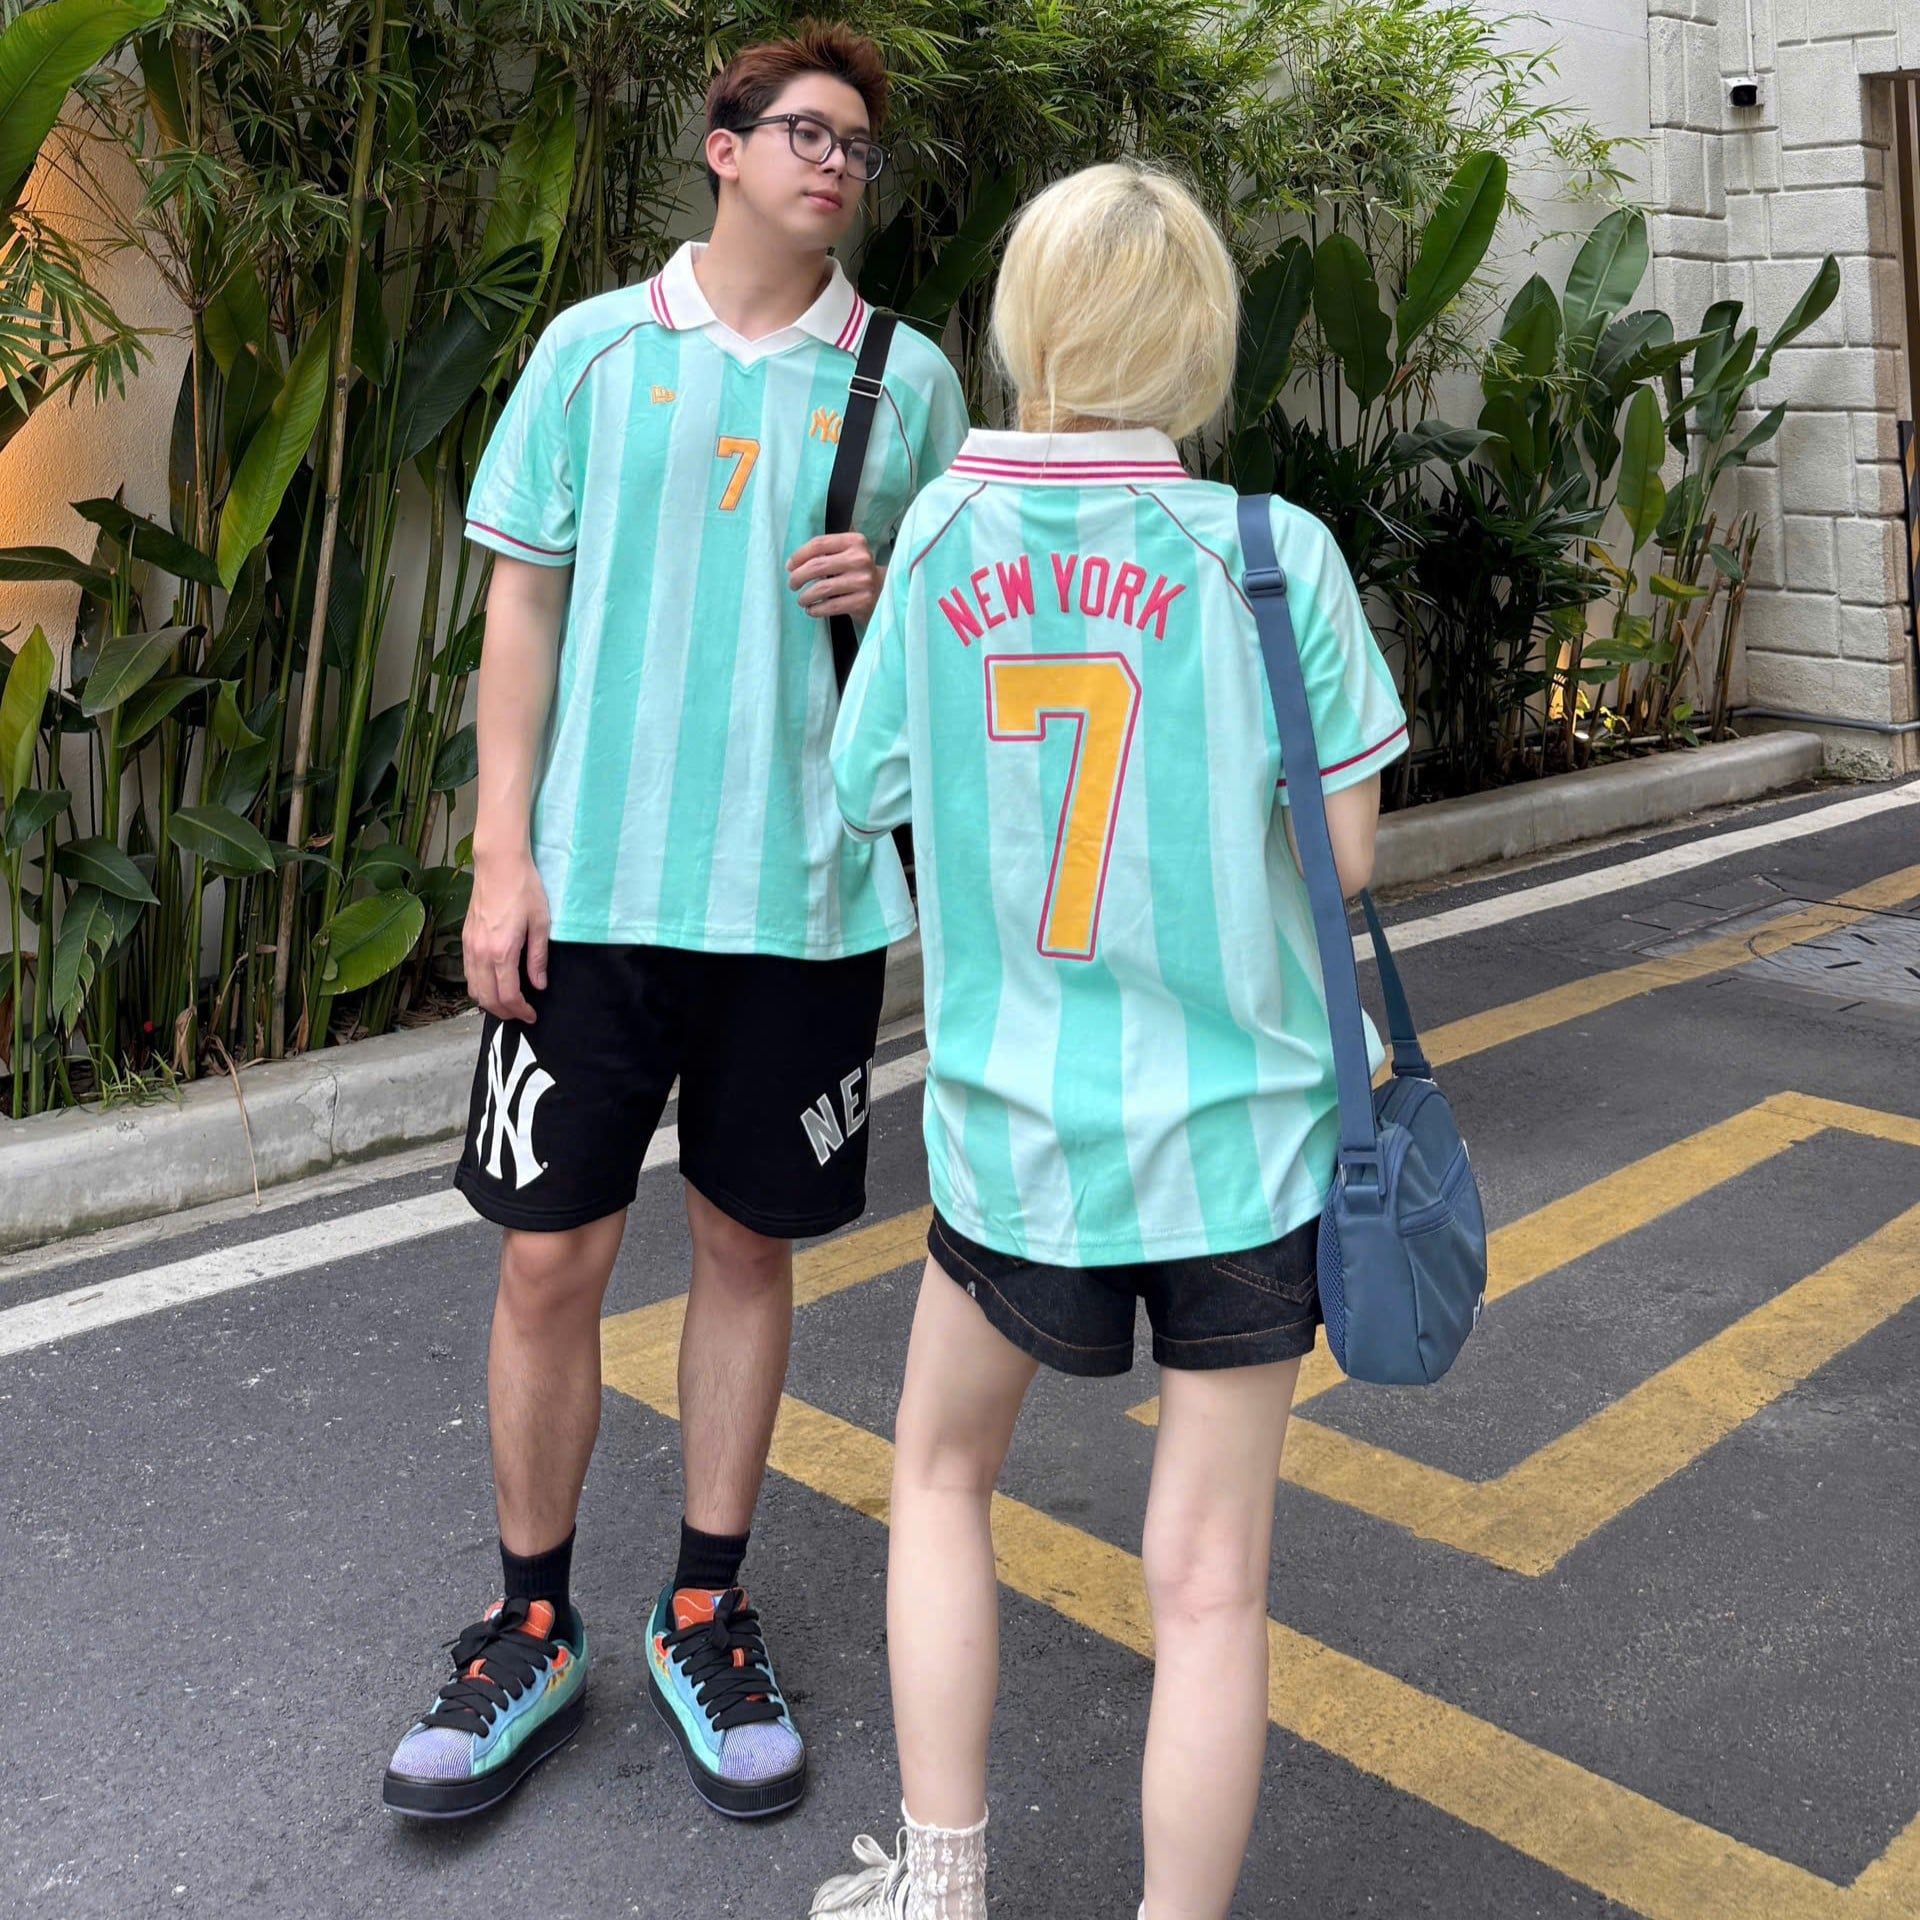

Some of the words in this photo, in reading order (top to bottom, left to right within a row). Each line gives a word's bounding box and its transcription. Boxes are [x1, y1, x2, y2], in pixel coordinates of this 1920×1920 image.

[716, 435, 761, 511] 7
[937, 554, 1035, 647] NEW
[1050, 553, 1186, 641] YORK
[984, 651, 1142, 962] 7
[800, 1057, 872, 1167] NE
